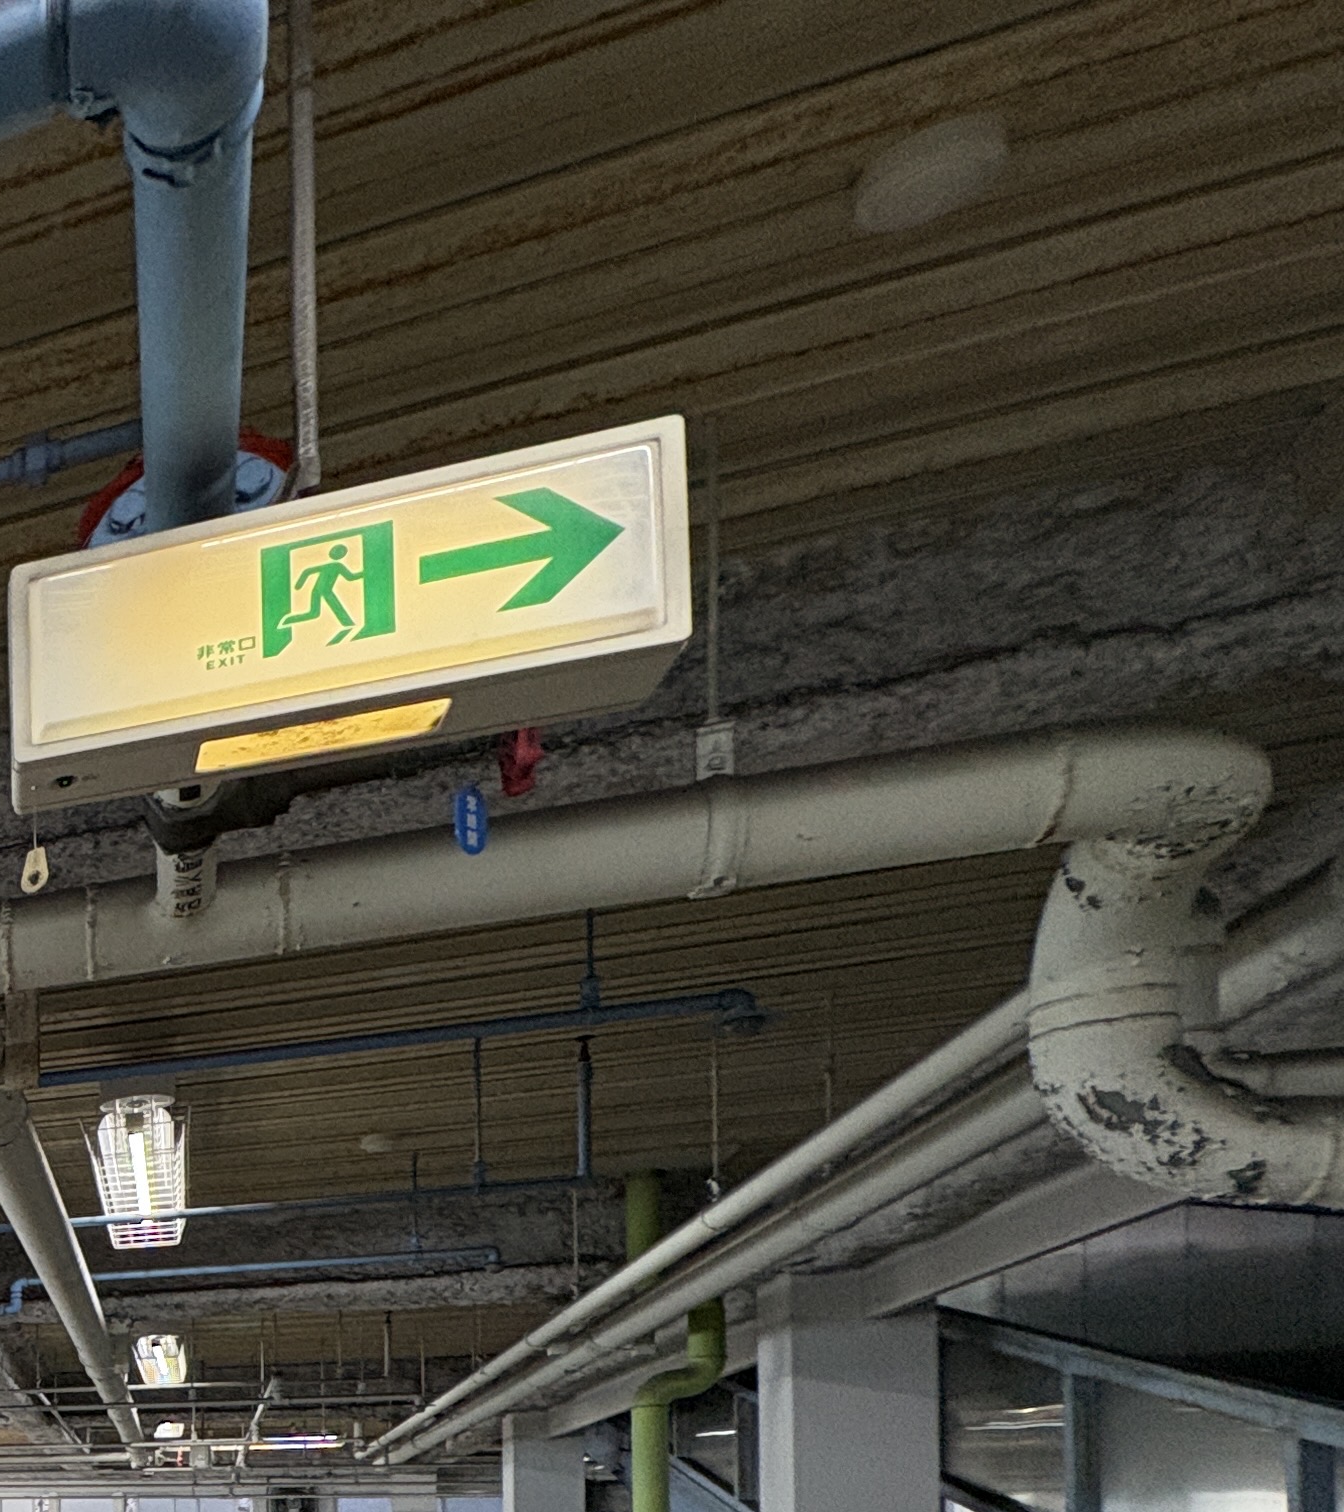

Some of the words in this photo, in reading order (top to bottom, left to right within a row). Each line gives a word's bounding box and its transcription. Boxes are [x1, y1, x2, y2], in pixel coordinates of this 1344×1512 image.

[197, 636, 256, 660] 非常口
[206, 654, 245, 670] EXIT
